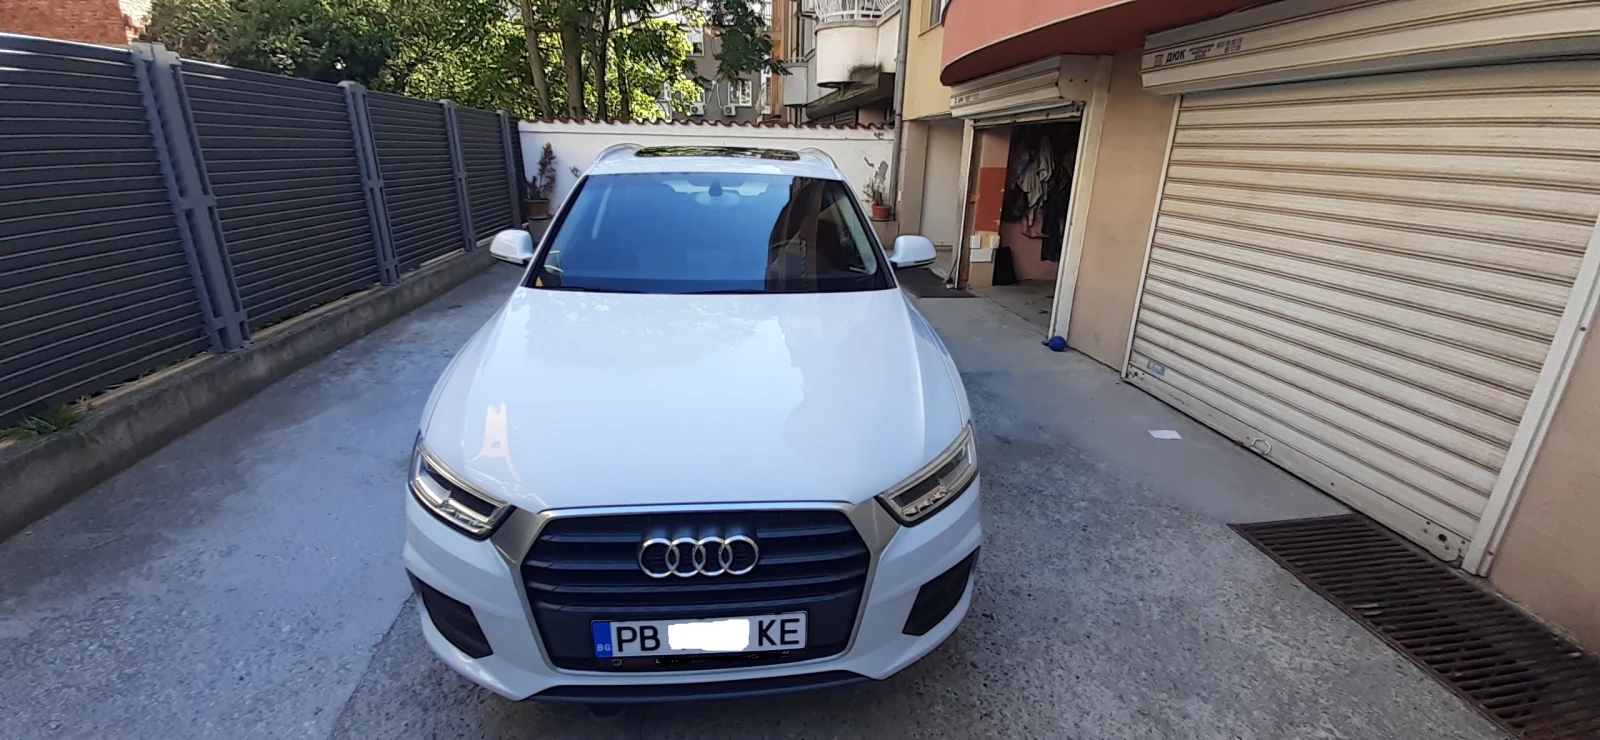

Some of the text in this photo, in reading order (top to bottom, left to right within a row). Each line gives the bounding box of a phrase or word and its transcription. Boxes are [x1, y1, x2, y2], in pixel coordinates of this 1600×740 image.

[1166, 50, 1187, 63] ДЮК
[616, 618, 800, 653] PB KE
[596, 643, 611, 652] BG
